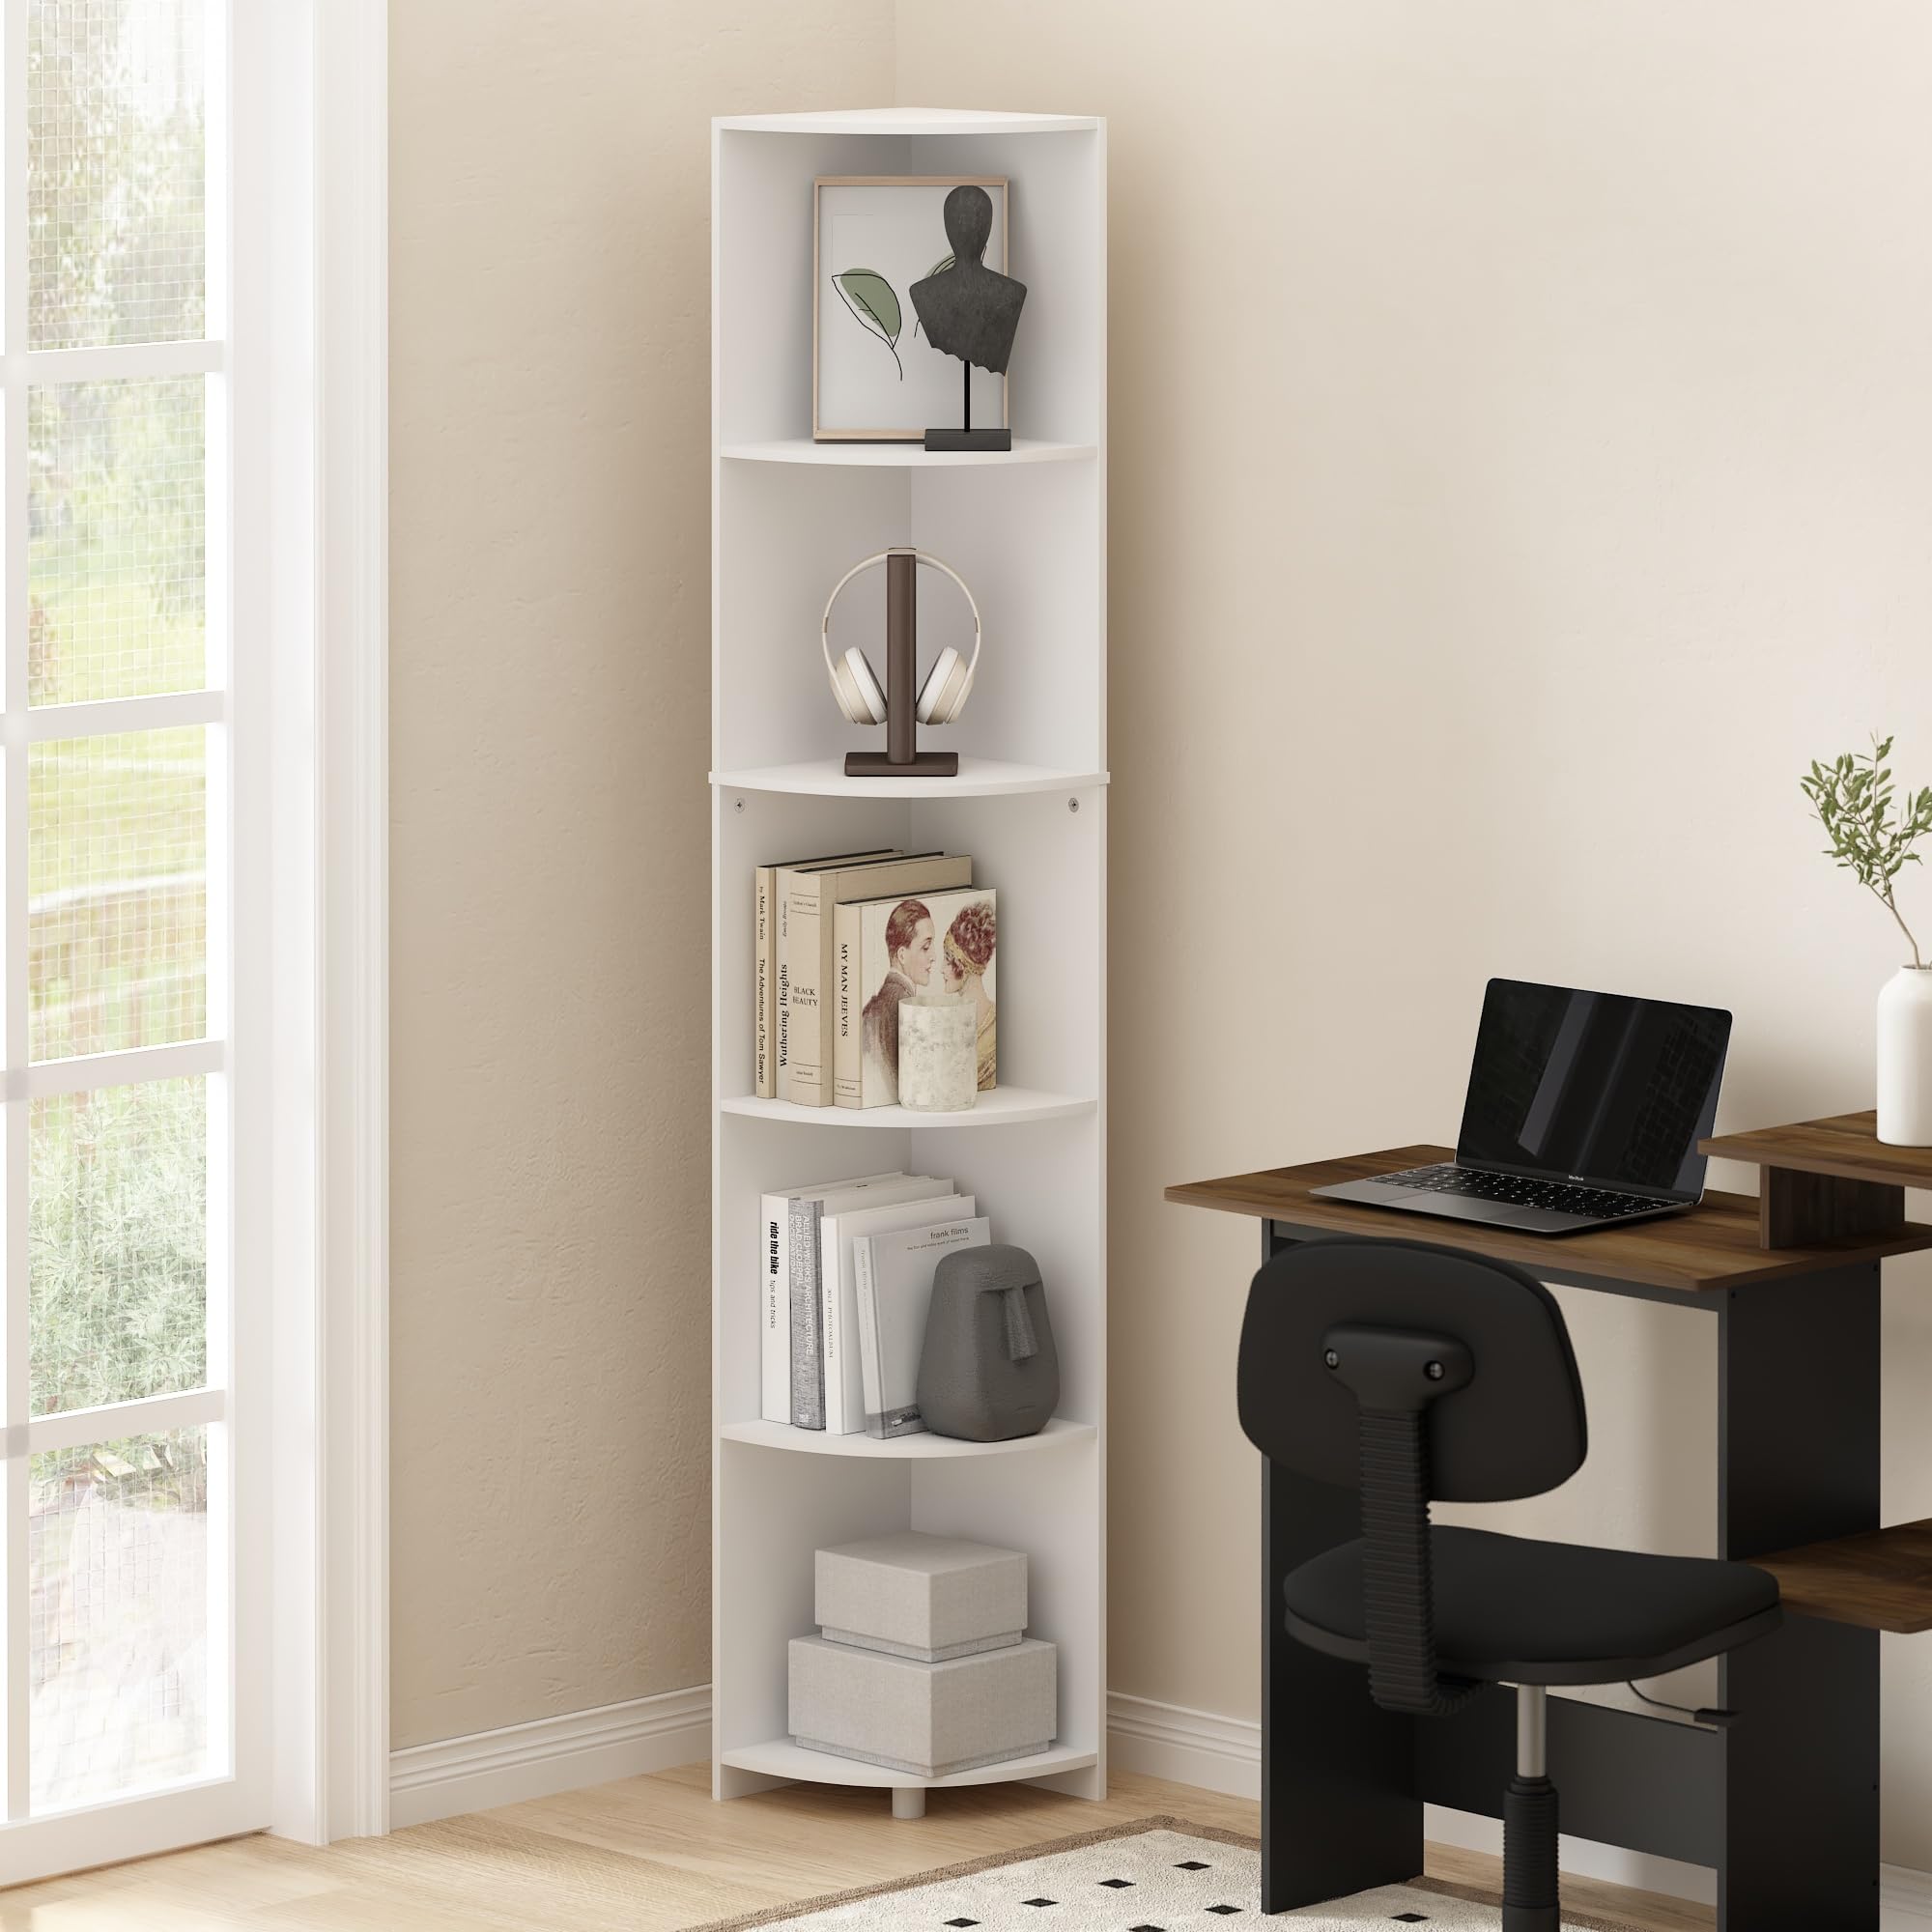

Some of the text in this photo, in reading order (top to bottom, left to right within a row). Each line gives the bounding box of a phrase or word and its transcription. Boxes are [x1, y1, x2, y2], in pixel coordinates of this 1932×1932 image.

[841, 943, 848, 962] MY
[794, 986, 815, 996] BLACK
[793, 996, 818, 1006] BEAUTY
[779, 964, 790, 1067] Wuthering Heights
[759, 1023, 765, 1032] of
[770, 1222, 779, 1239] ride
[795, 1215, 803, 1241] BRAD
[930, 1227, 969, 1239] frank films
[770, 1240, 779, 1254] the
[770, 1256, 779, 1275] bike
[803, 1215, 813, 1355] ALLIED WORKS ARCHITECTURE
